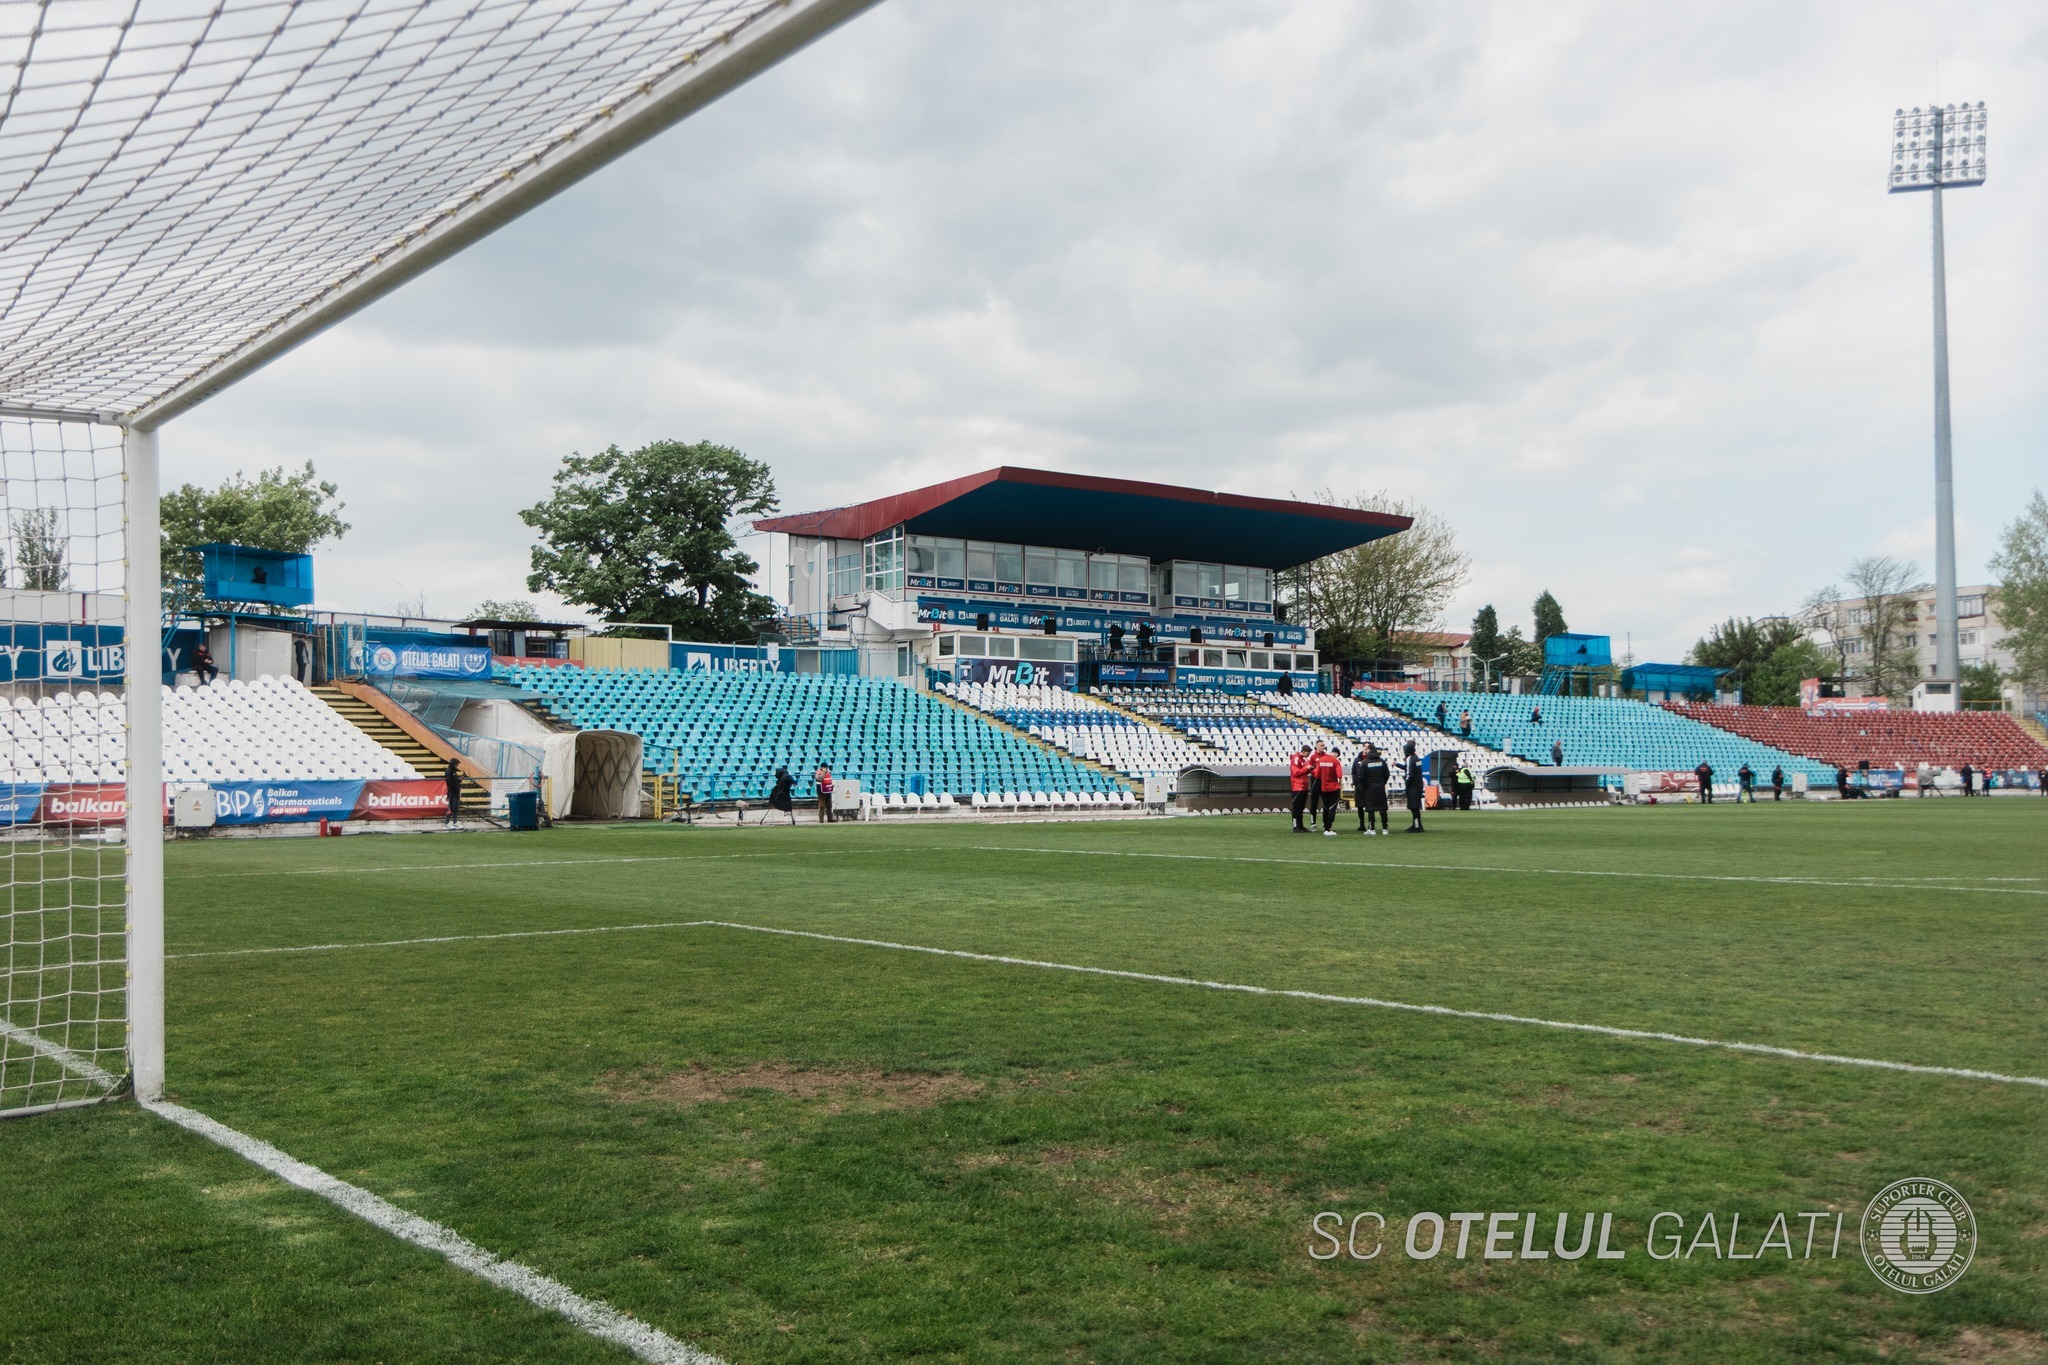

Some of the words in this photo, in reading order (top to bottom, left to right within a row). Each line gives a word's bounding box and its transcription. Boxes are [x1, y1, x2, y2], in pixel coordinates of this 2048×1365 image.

[910, 578, 933, 587] MrBit
[998, 585, 1020, 593] MrBit
[1094, 592, 1114, 600] MrBit
[1202, 599, 1220, 608] MrBit
[918, 608, 947, 619] MrBit
[1224, 627, 1247, 637] MrBit
[714, 657, 780, 677] LIBERTY
[988, 662, 1050, 685] MrBit
[1195, 675, 1216, 683] LIBERTY
[267, 788, 298, 797] Balkan
[268, 796, 342, 807] Pharmaceuticals
